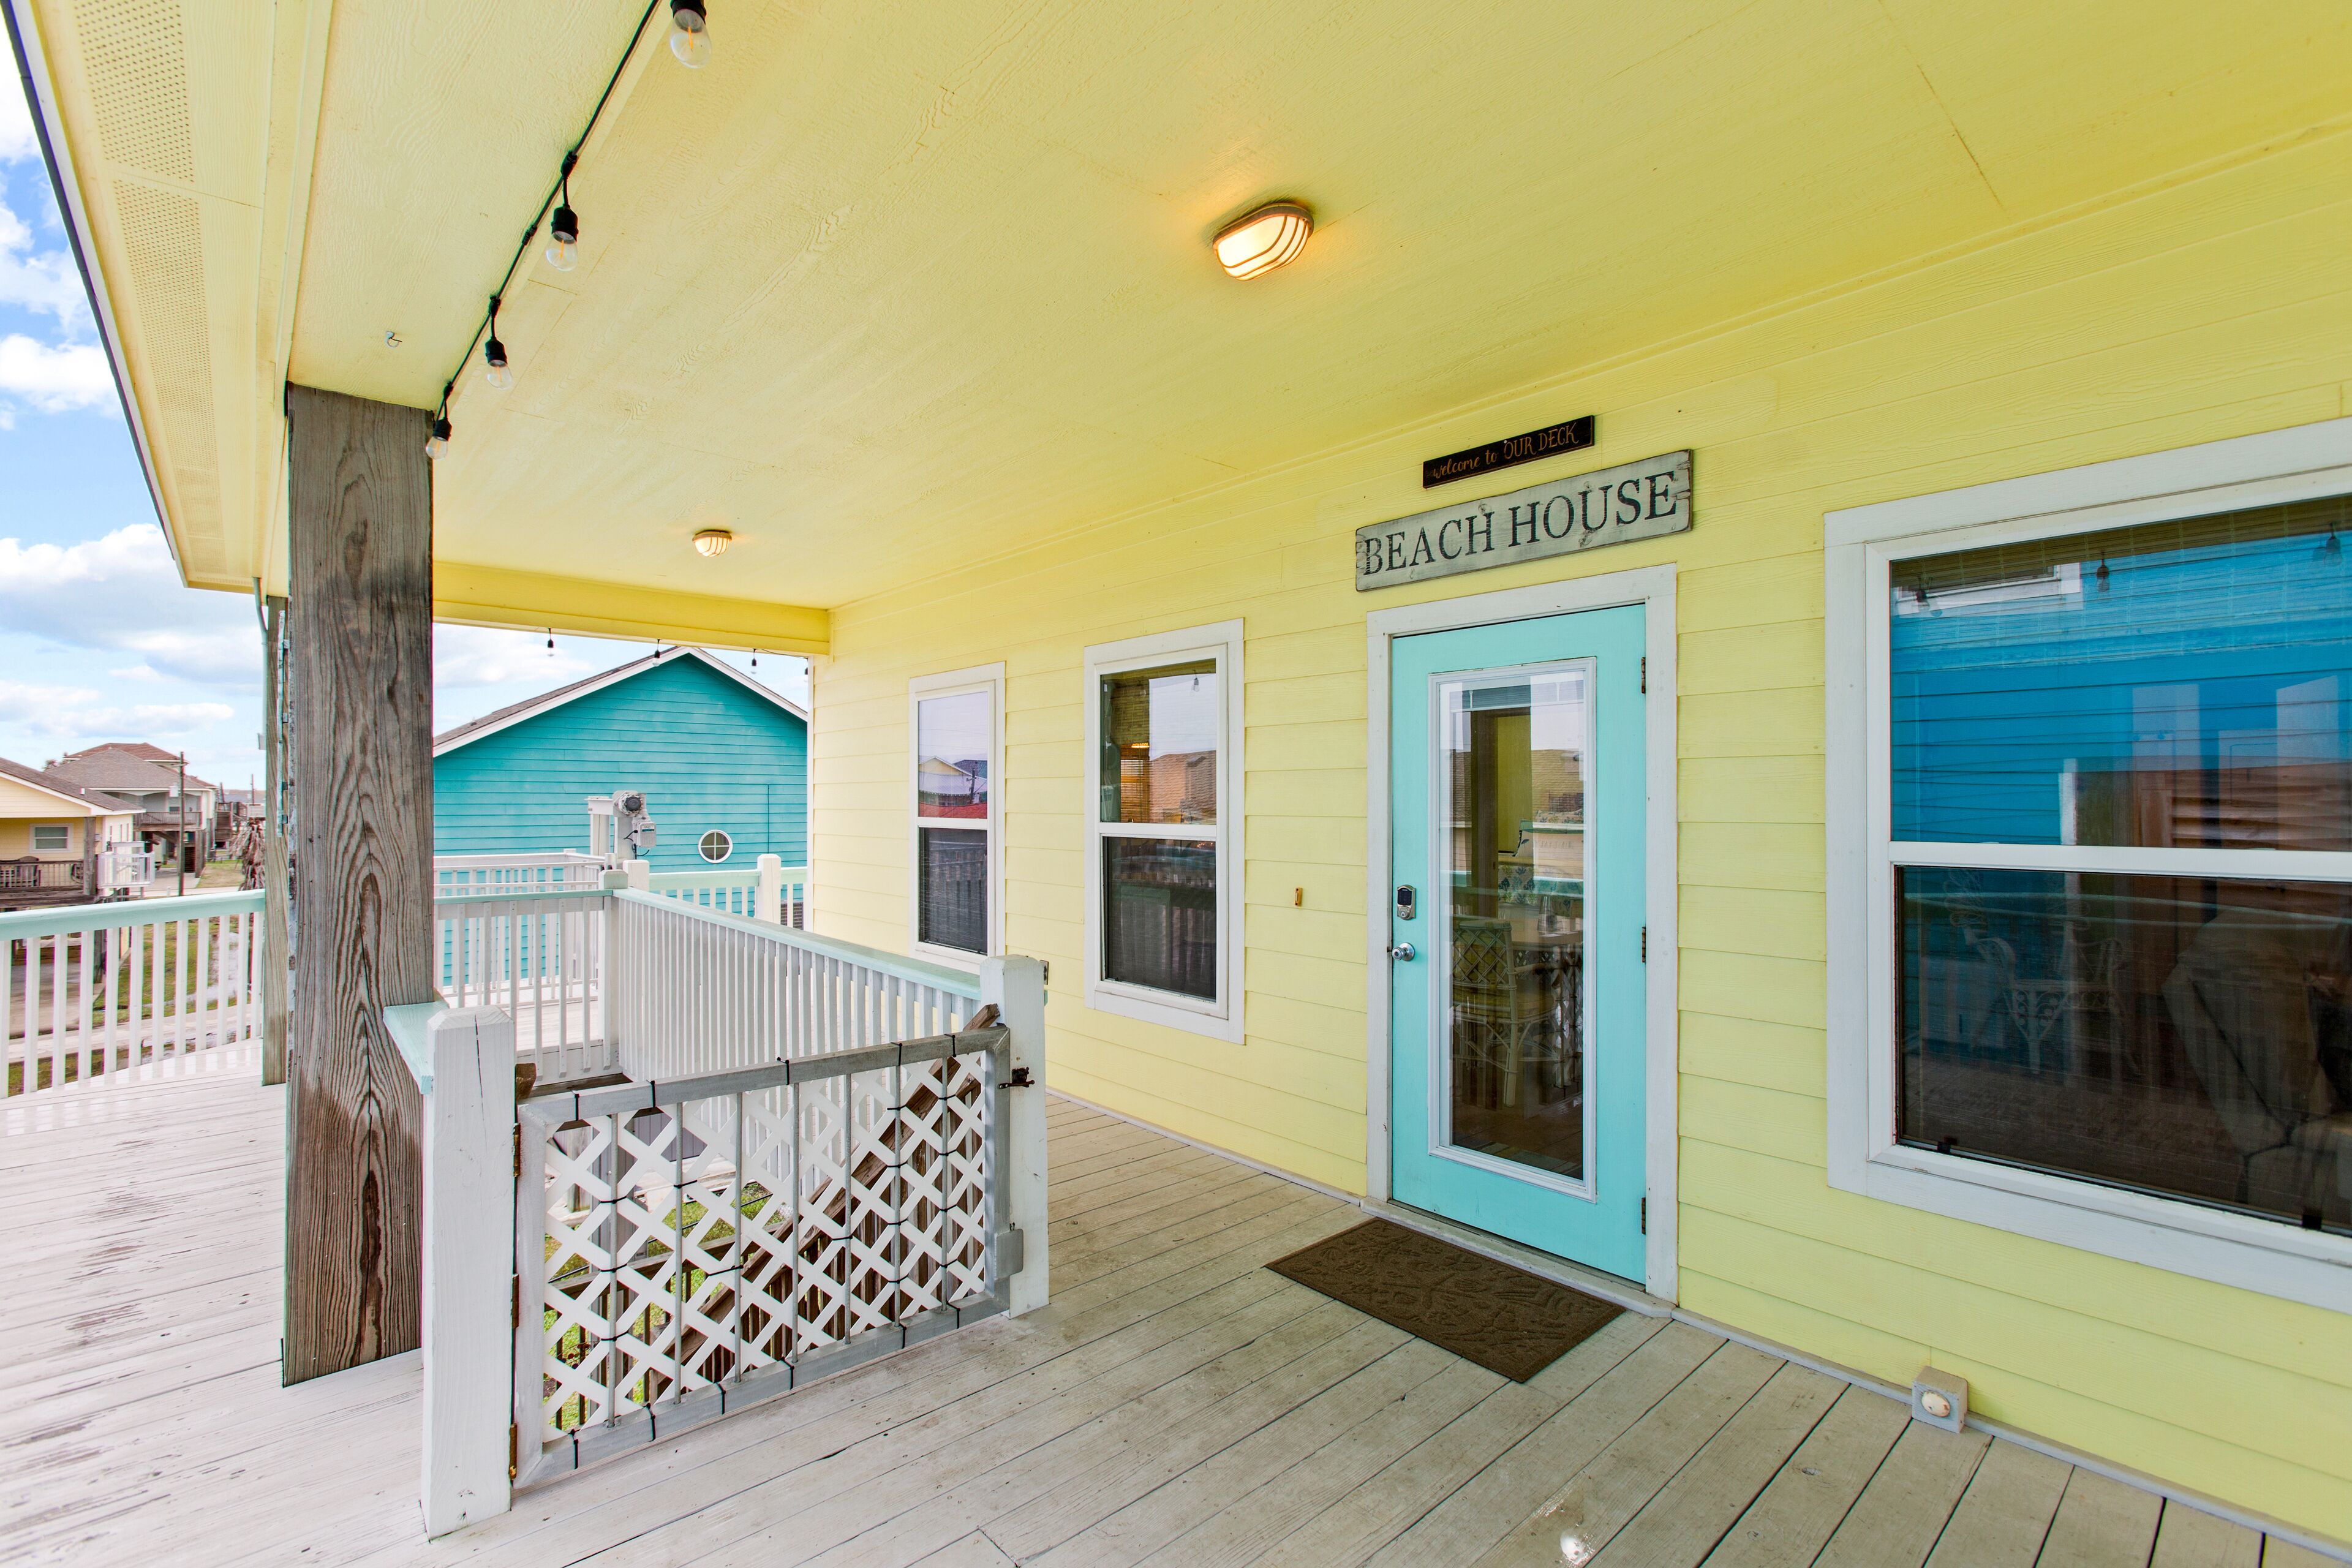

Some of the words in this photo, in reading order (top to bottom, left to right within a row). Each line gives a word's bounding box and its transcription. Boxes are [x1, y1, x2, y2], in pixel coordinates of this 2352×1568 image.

[1485, 449, 1498, 465] to
[1504, 437, 1537, 459] OUR
[1538, 422, 1579, 451] DECK
[1363, 511, 1495, 575] BEACH
[1509, 471, 1678, 547] HOUSE
